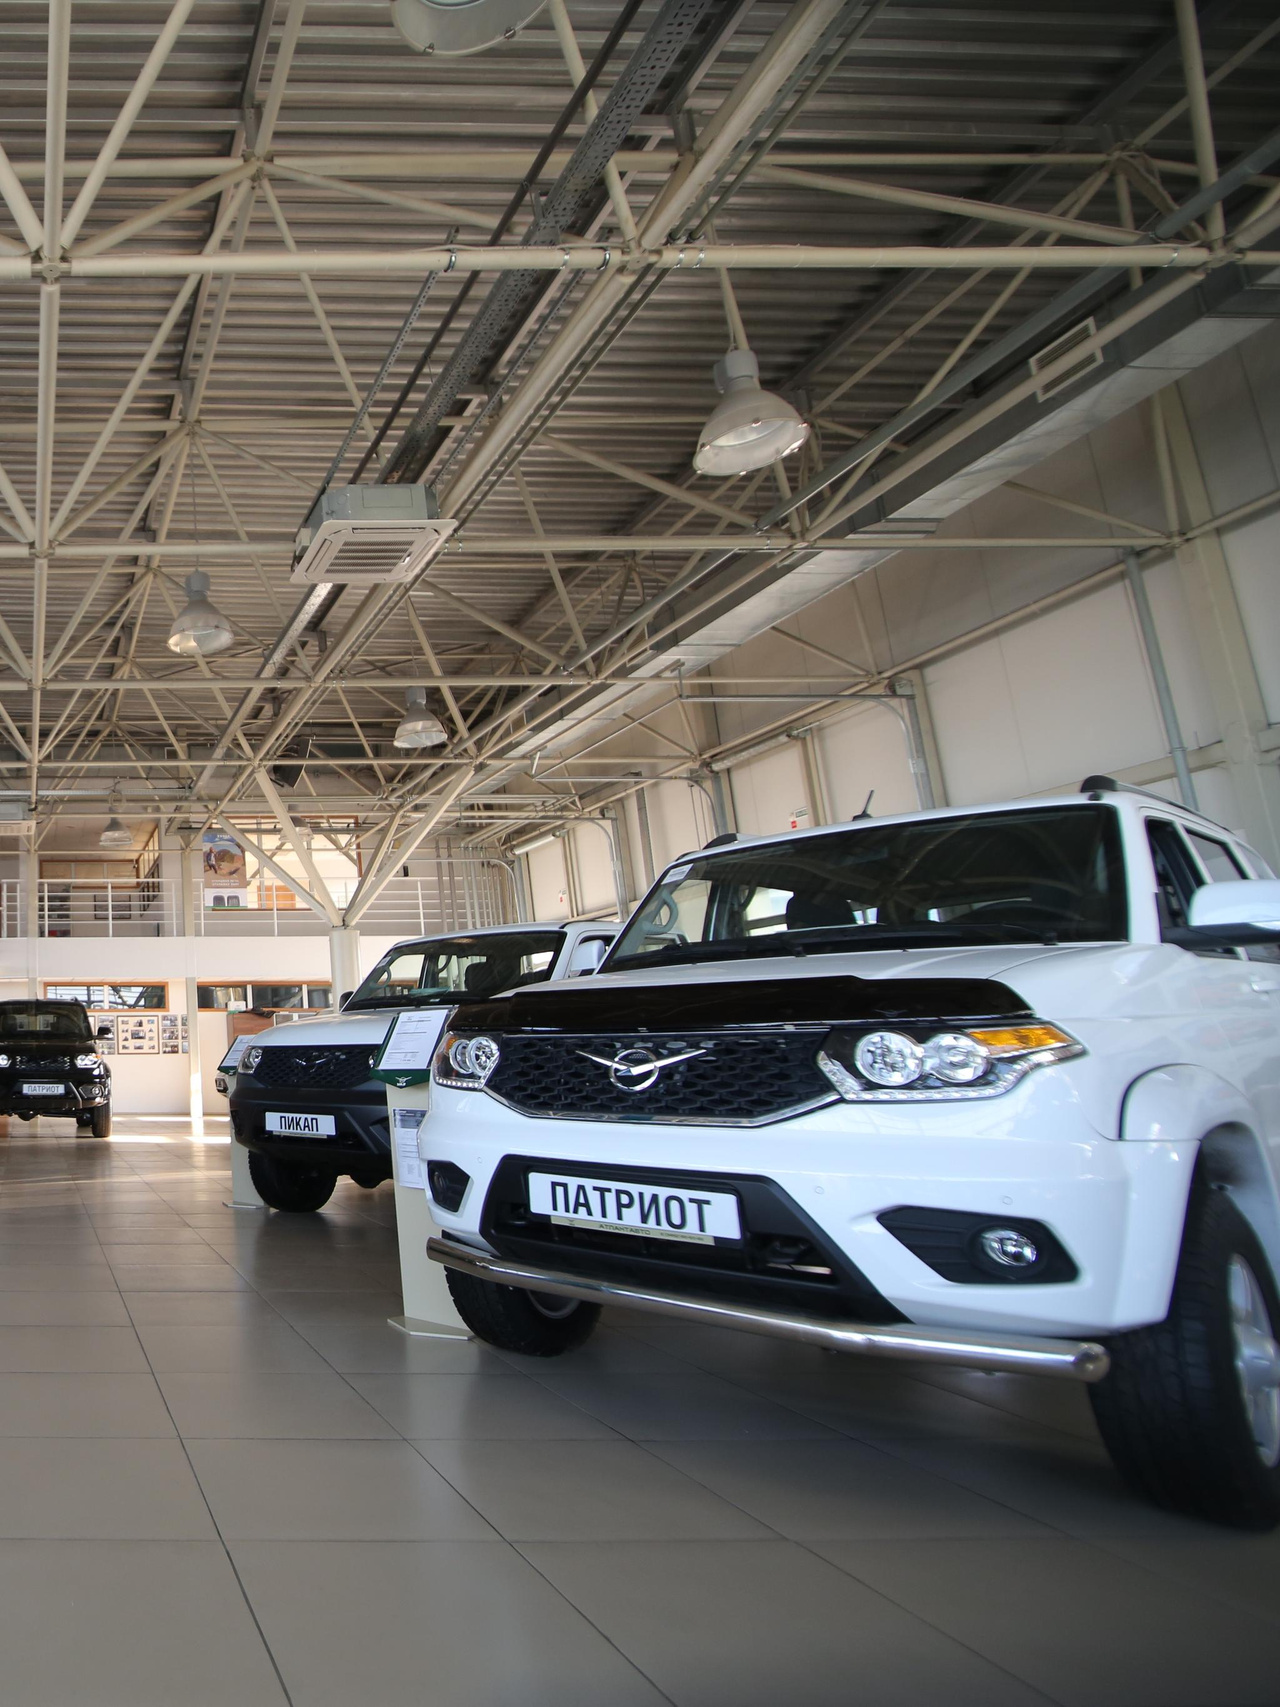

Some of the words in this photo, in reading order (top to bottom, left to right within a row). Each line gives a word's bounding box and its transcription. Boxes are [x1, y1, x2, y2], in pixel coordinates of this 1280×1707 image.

[27, 1085, 60, 1093] ПАТРИОТ
[279, 1115, 319, 1132] ПИКАП
[550, 1180, 712, 1233] ПАТРИОТ
[598, 1223, 651, 1236] АТЛАНТАВТО
